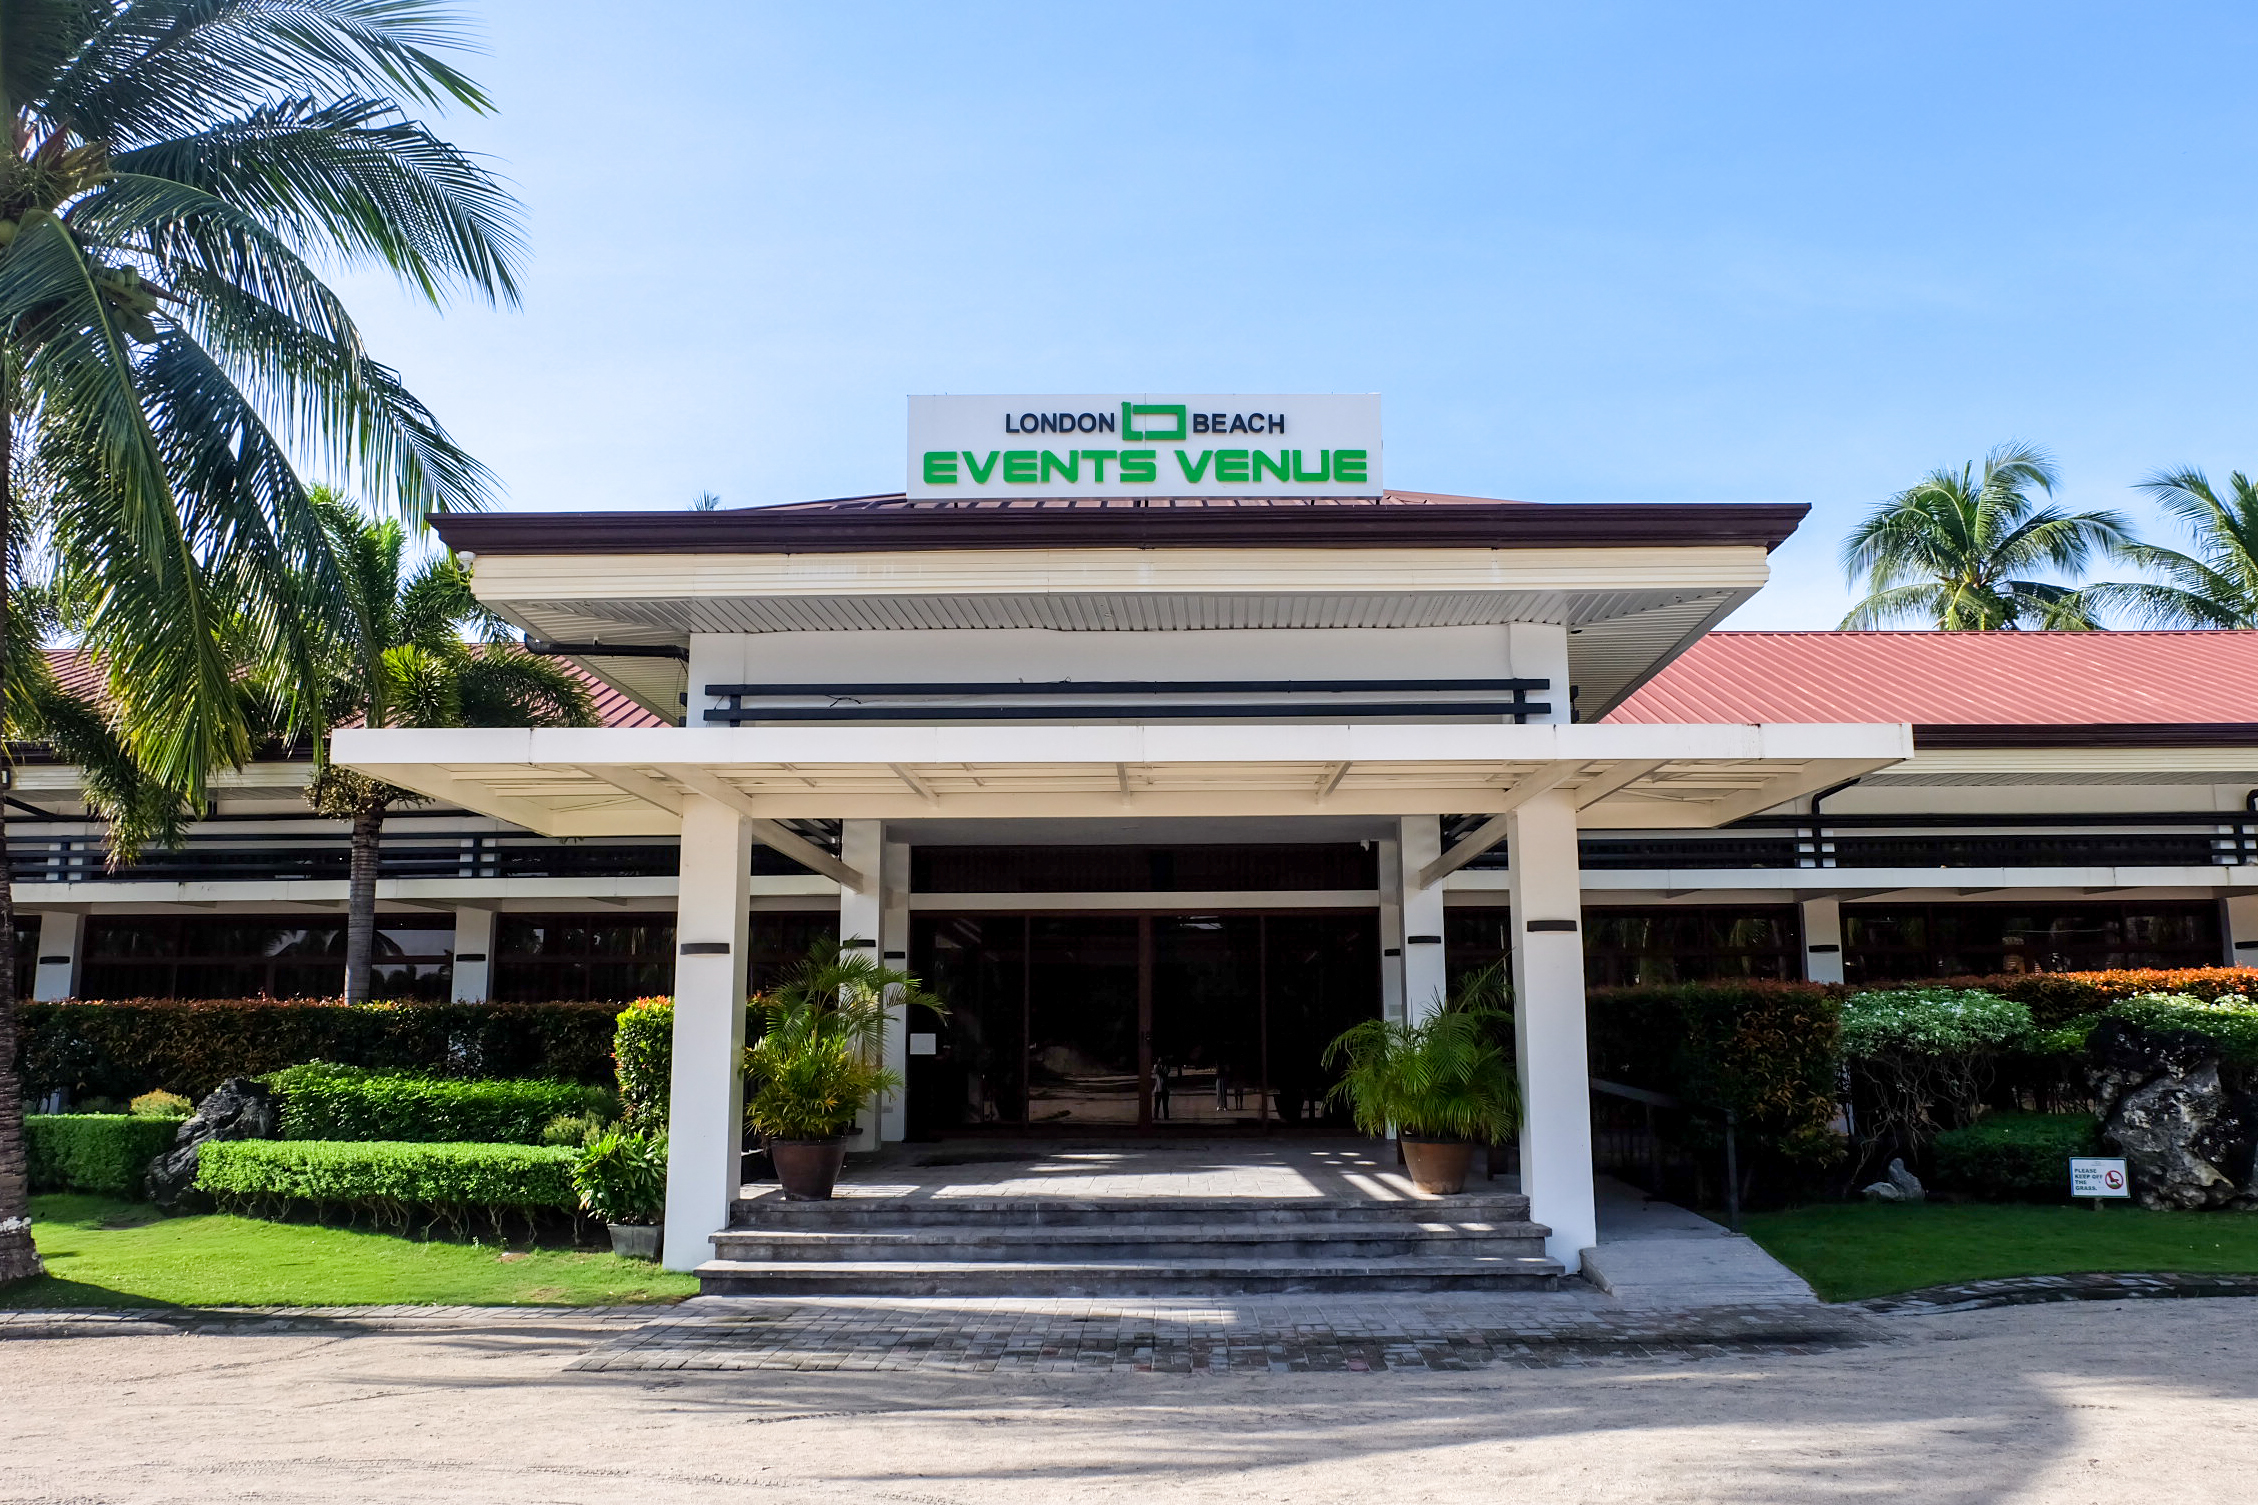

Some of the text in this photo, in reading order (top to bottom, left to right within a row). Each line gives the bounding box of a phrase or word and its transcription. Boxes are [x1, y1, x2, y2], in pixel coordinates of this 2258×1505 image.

[1005, 412, 1285, 434] LONDON BEACH
[923, 449, 1367, 484] EVENTS VENUE
